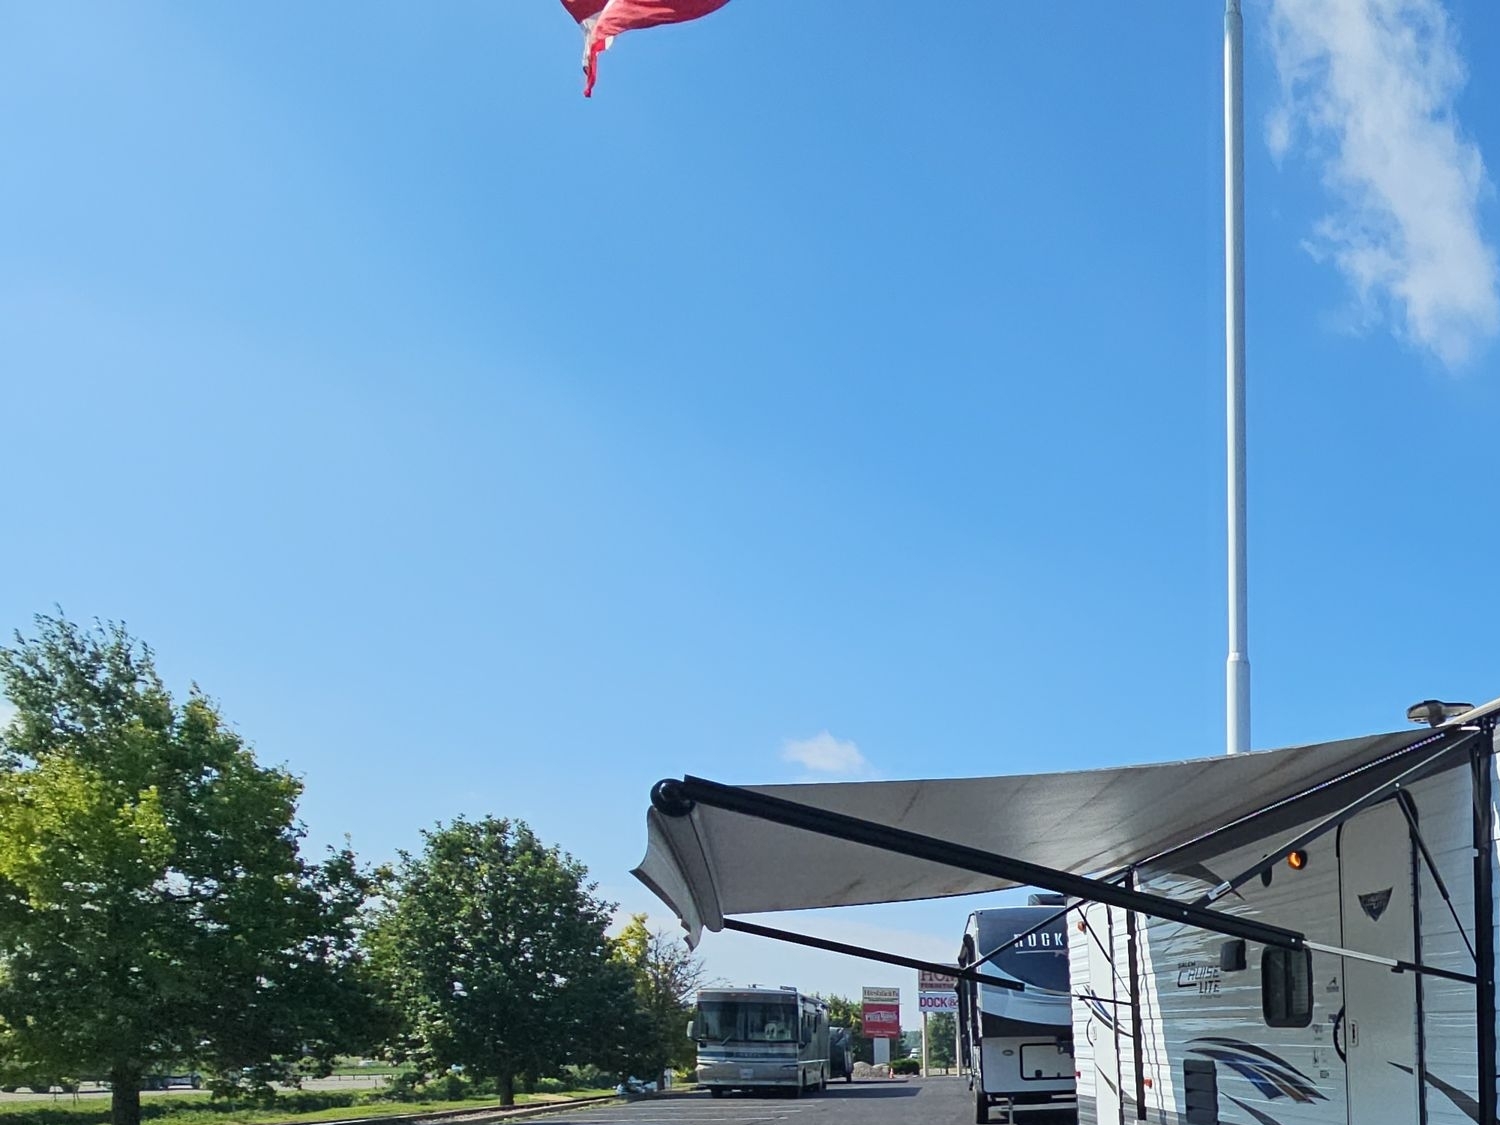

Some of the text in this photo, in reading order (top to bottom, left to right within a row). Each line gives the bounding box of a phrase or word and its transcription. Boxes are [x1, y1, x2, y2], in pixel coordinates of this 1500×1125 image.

[1177, 966, 1222, 988] CRUISE
[1199, 980, 1221, 994] LITE
[920, 997, 948, 1008] DOCK
